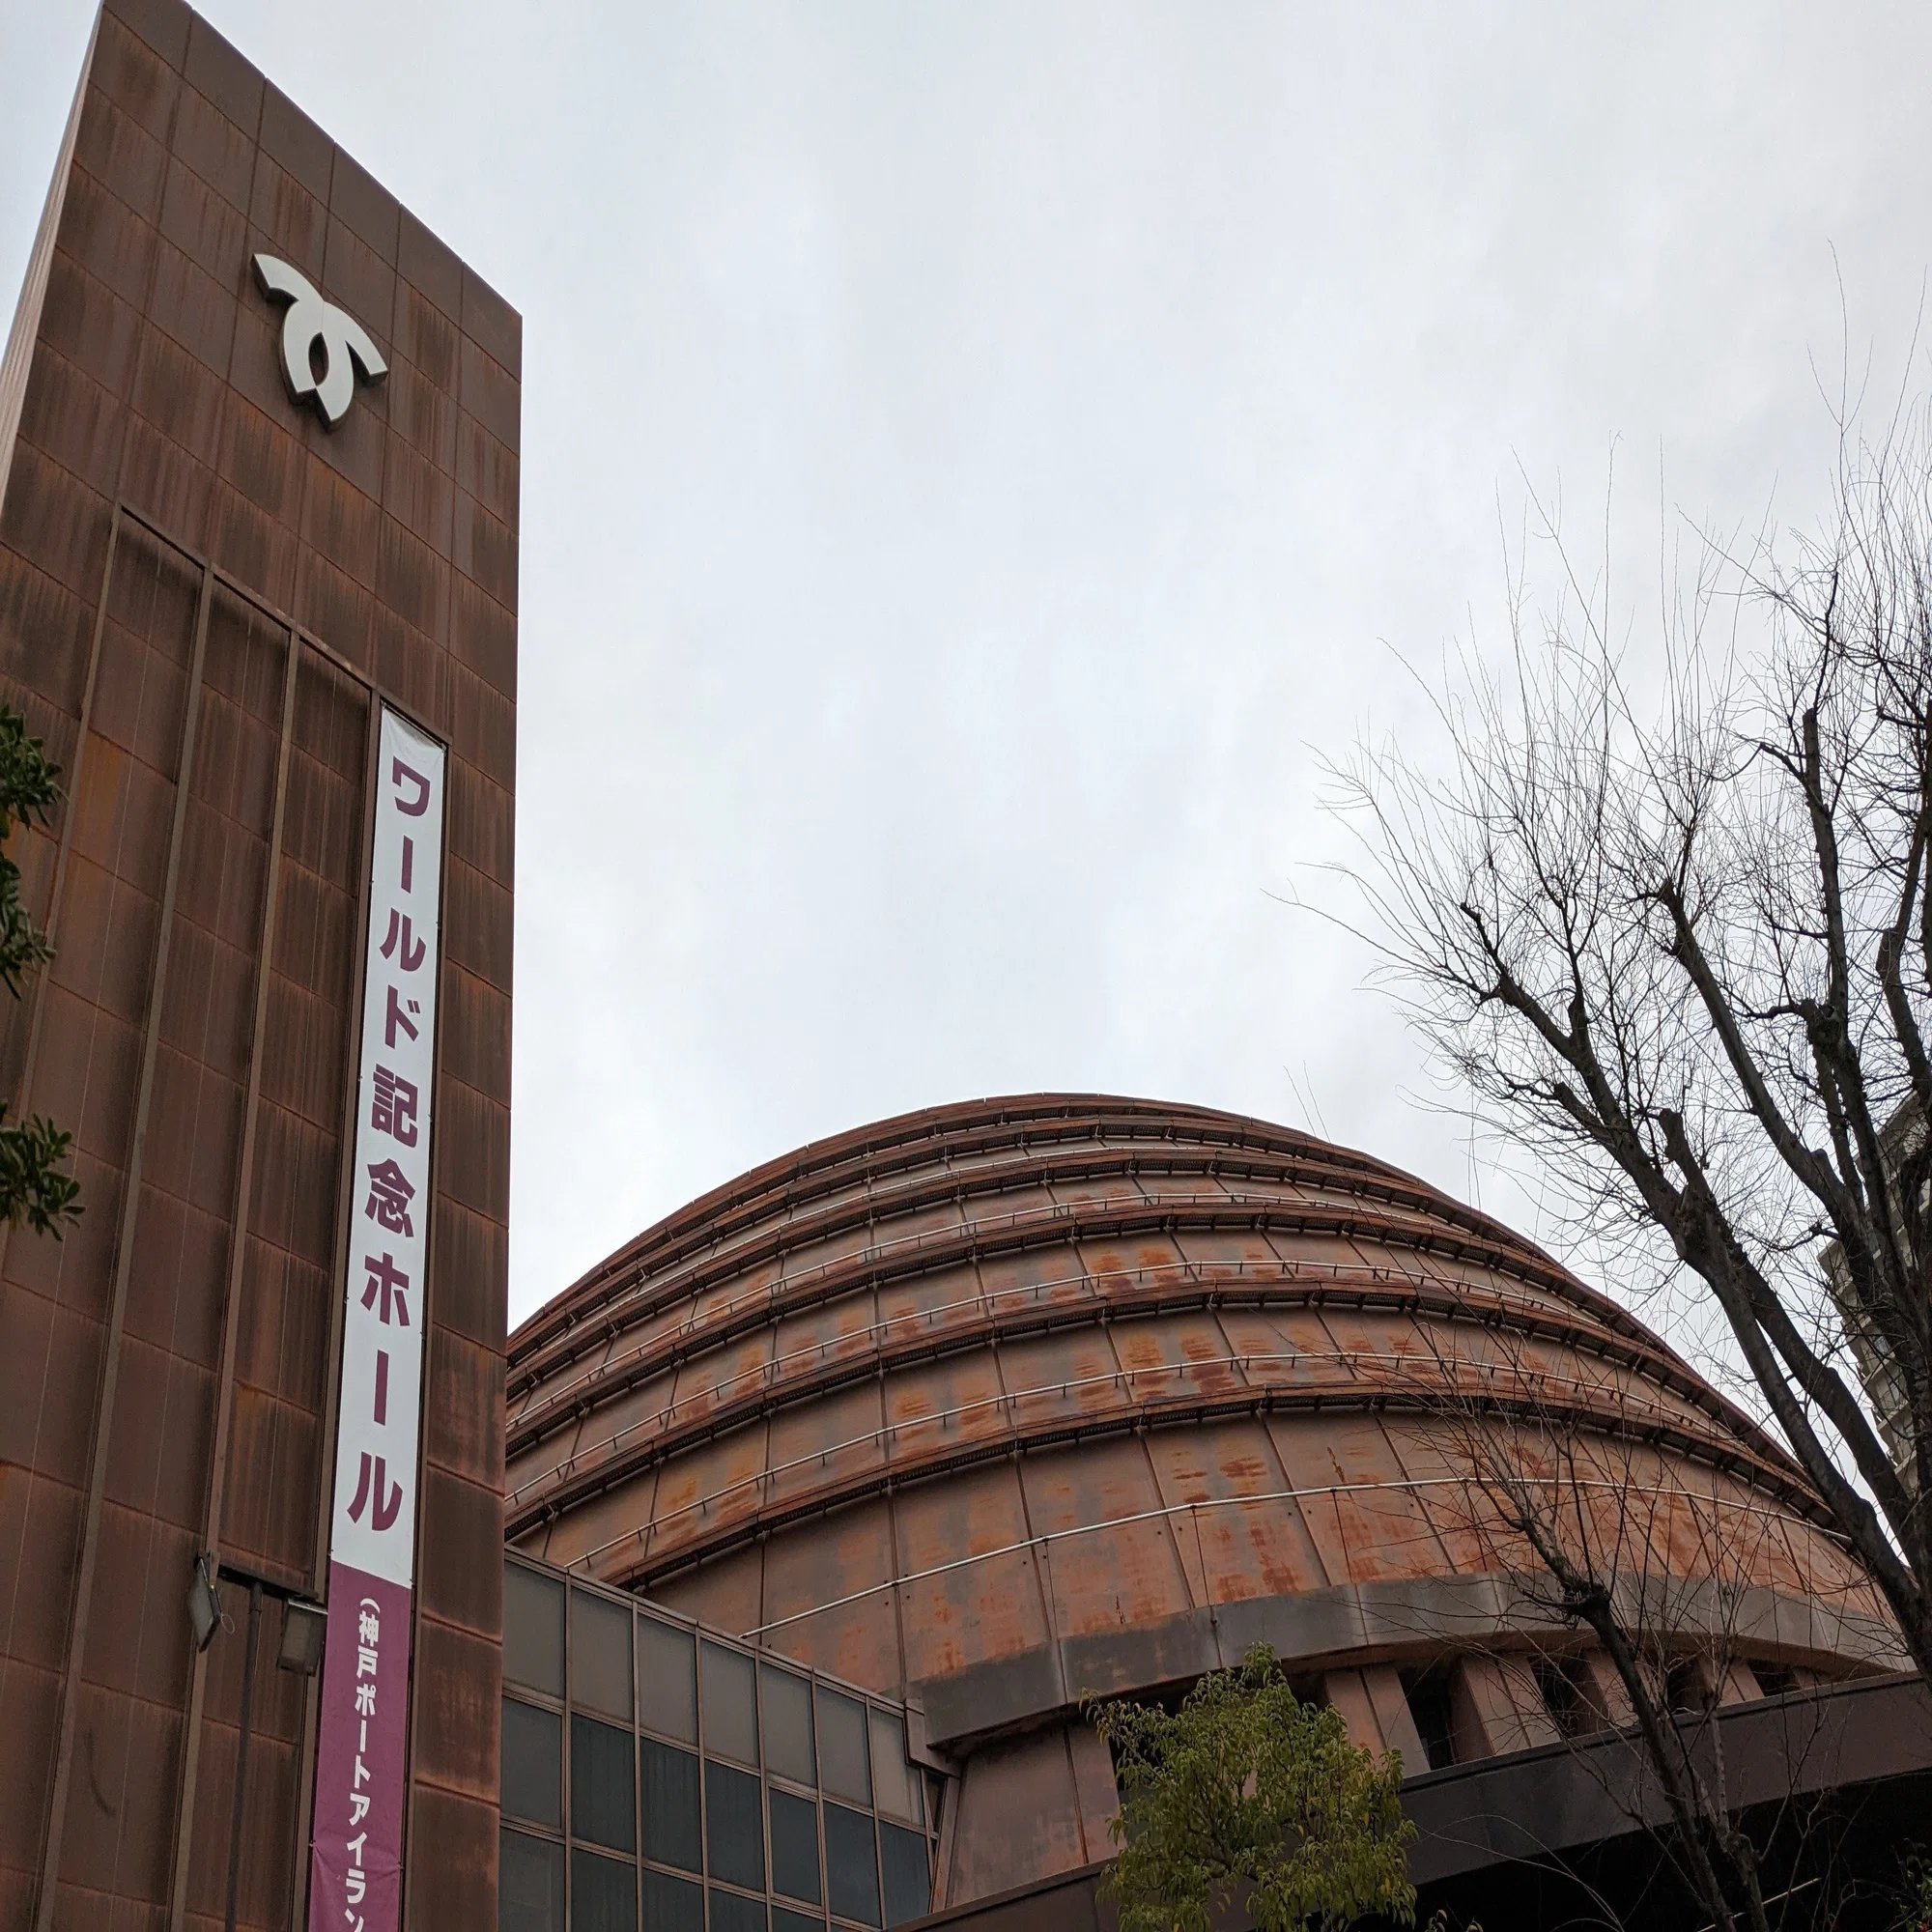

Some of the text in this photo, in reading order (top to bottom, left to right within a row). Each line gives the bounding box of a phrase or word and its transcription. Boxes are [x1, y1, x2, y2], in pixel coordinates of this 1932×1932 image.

[347, 755, 431, 1532] ワールド記念ホール
